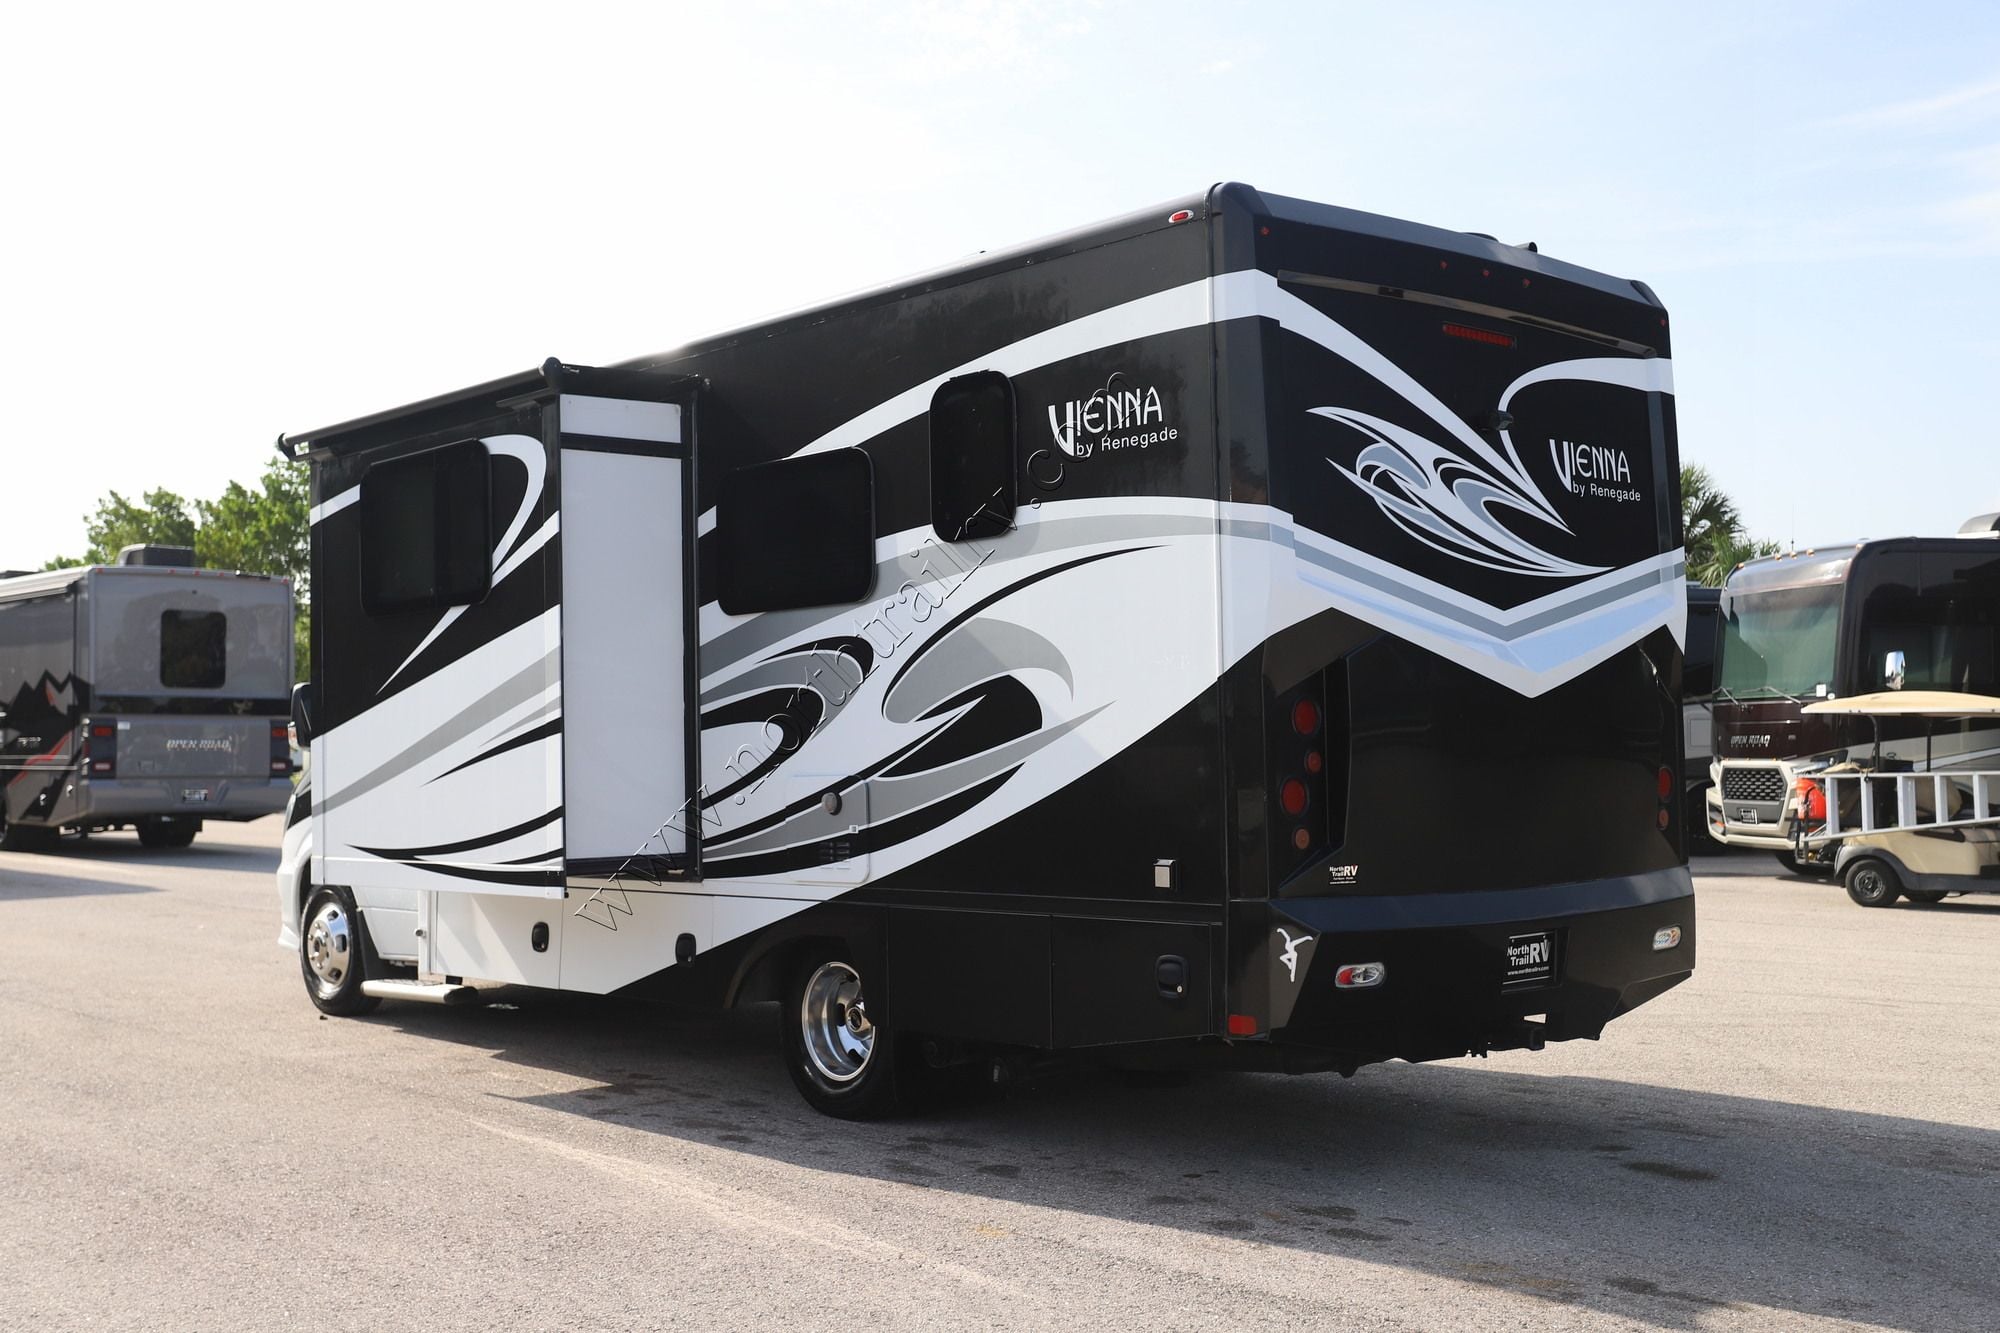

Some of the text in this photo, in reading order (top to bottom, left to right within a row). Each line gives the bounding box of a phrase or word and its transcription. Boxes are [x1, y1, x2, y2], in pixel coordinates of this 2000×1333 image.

[1047, 385, 1163, 457] VIENNA
[1076, 426, 1178, 458] by Renegade
[1549, 438, 1631, 492] VIENNA
[1572, 480, 1641, 503] by Renegade
[1344, 864, 1359, 877] RV
[1506, 939, 1551, 964] North RV
[1510, 954, 1530, 967] Trail
